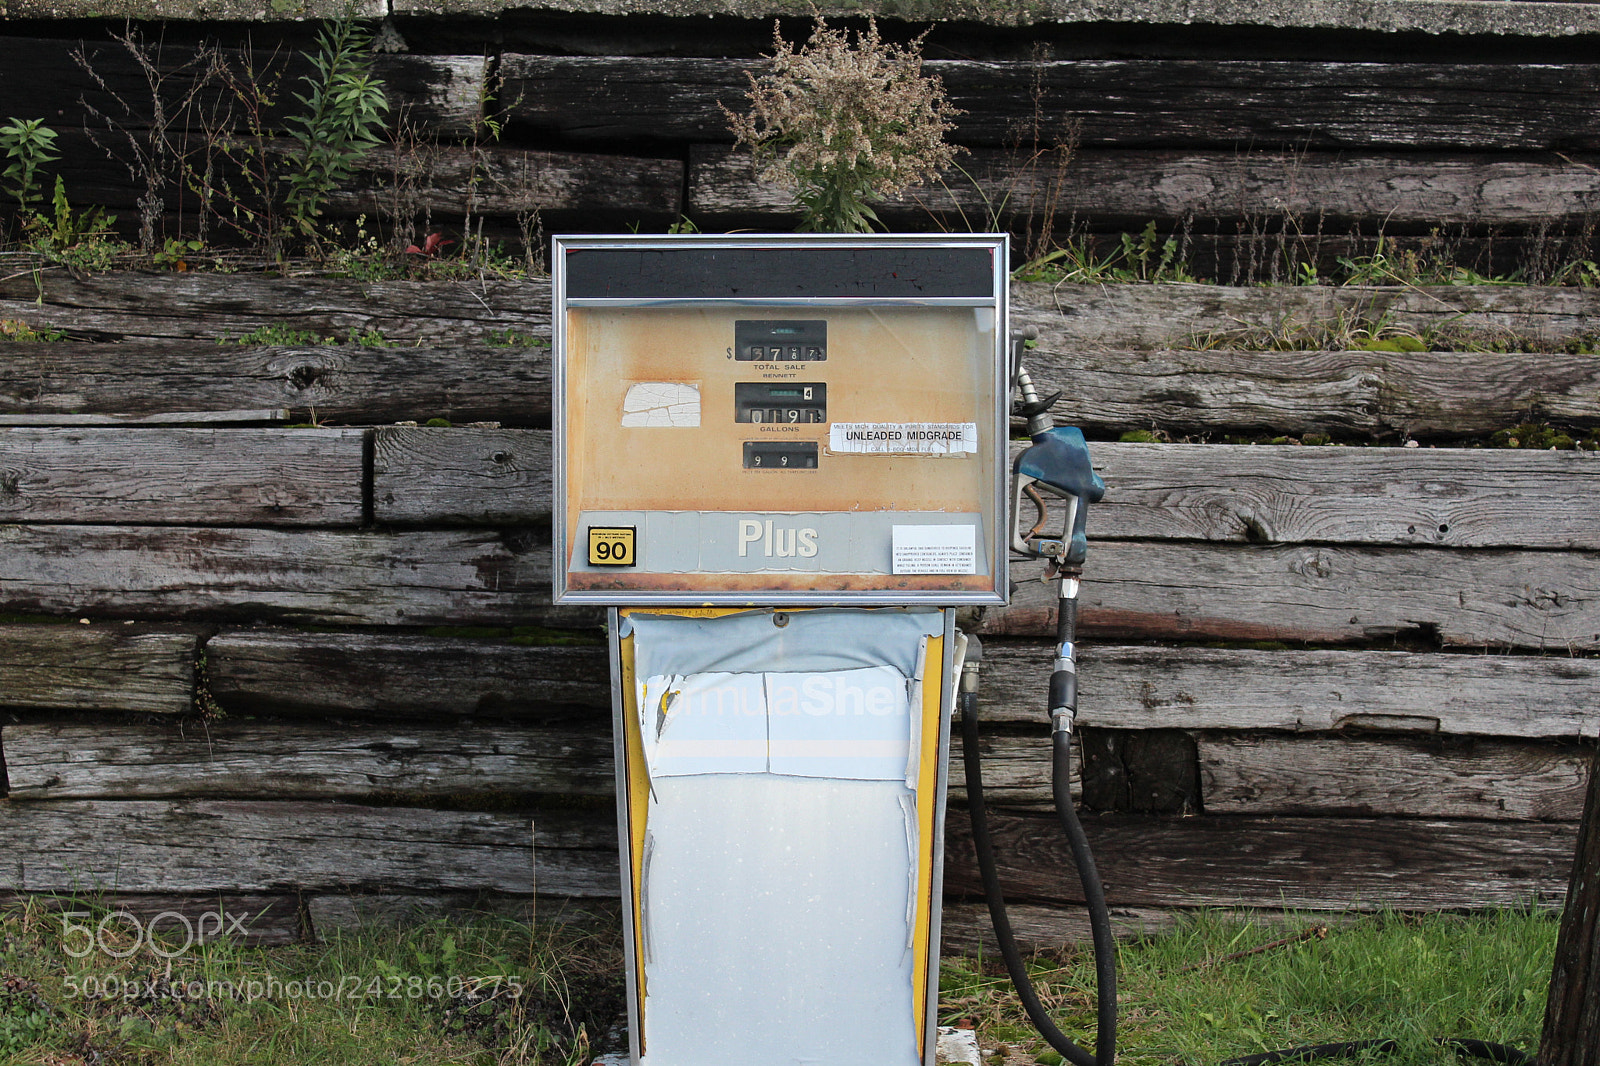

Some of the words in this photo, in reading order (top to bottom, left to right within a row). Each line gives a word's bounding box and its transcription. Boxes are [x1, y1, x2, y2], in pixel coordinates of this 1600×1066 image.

[846, 431, 902, 441] UNLEADED
[906, 431, 962, 441] MIDGRADE
[738, 519, 819, 558] Plus
[596, 541, 627, 560] 90
